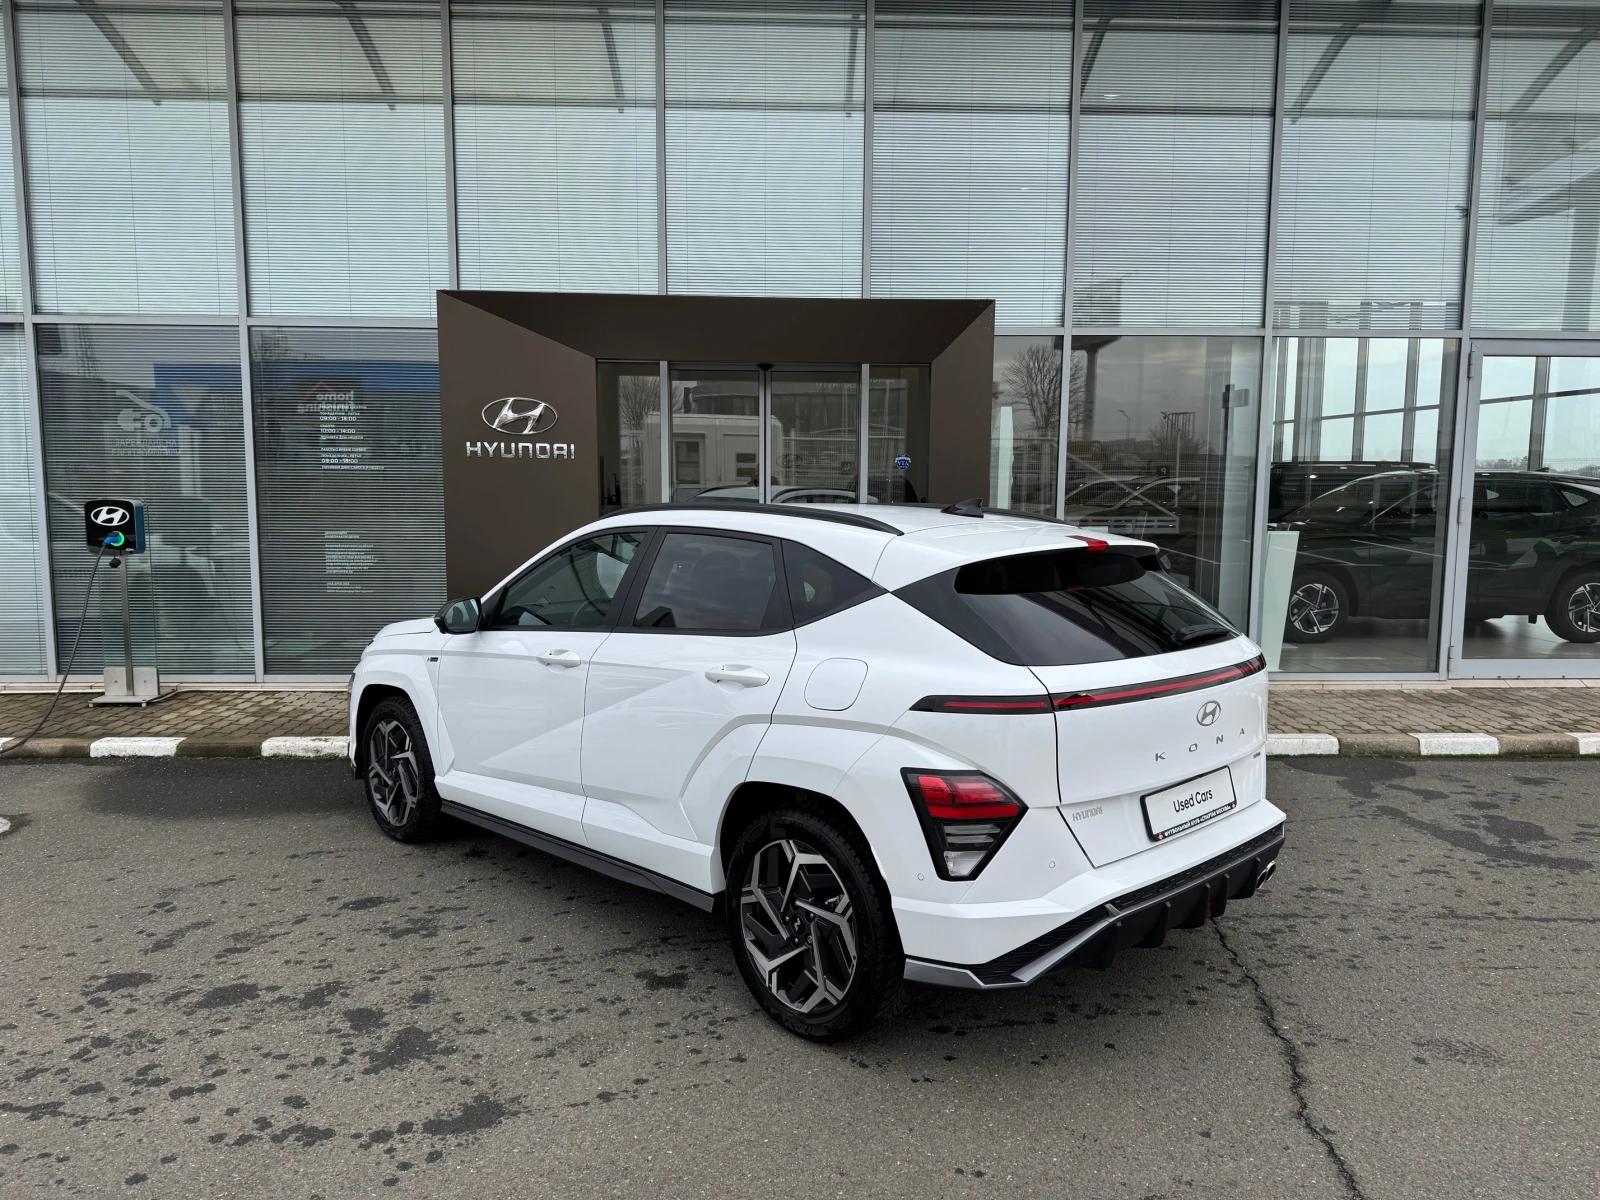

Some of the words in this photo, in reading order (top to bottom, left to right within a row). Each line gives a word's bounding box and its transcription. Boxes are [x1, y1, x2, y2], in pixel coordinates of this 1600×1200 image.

[466, 441, 575, 460] HYUNDAI
[1173, 793, 1194, 813] Used
[1195, 789, 1213, 805] Cars
[1072, 806, 1103, 821] HYUNDAI
